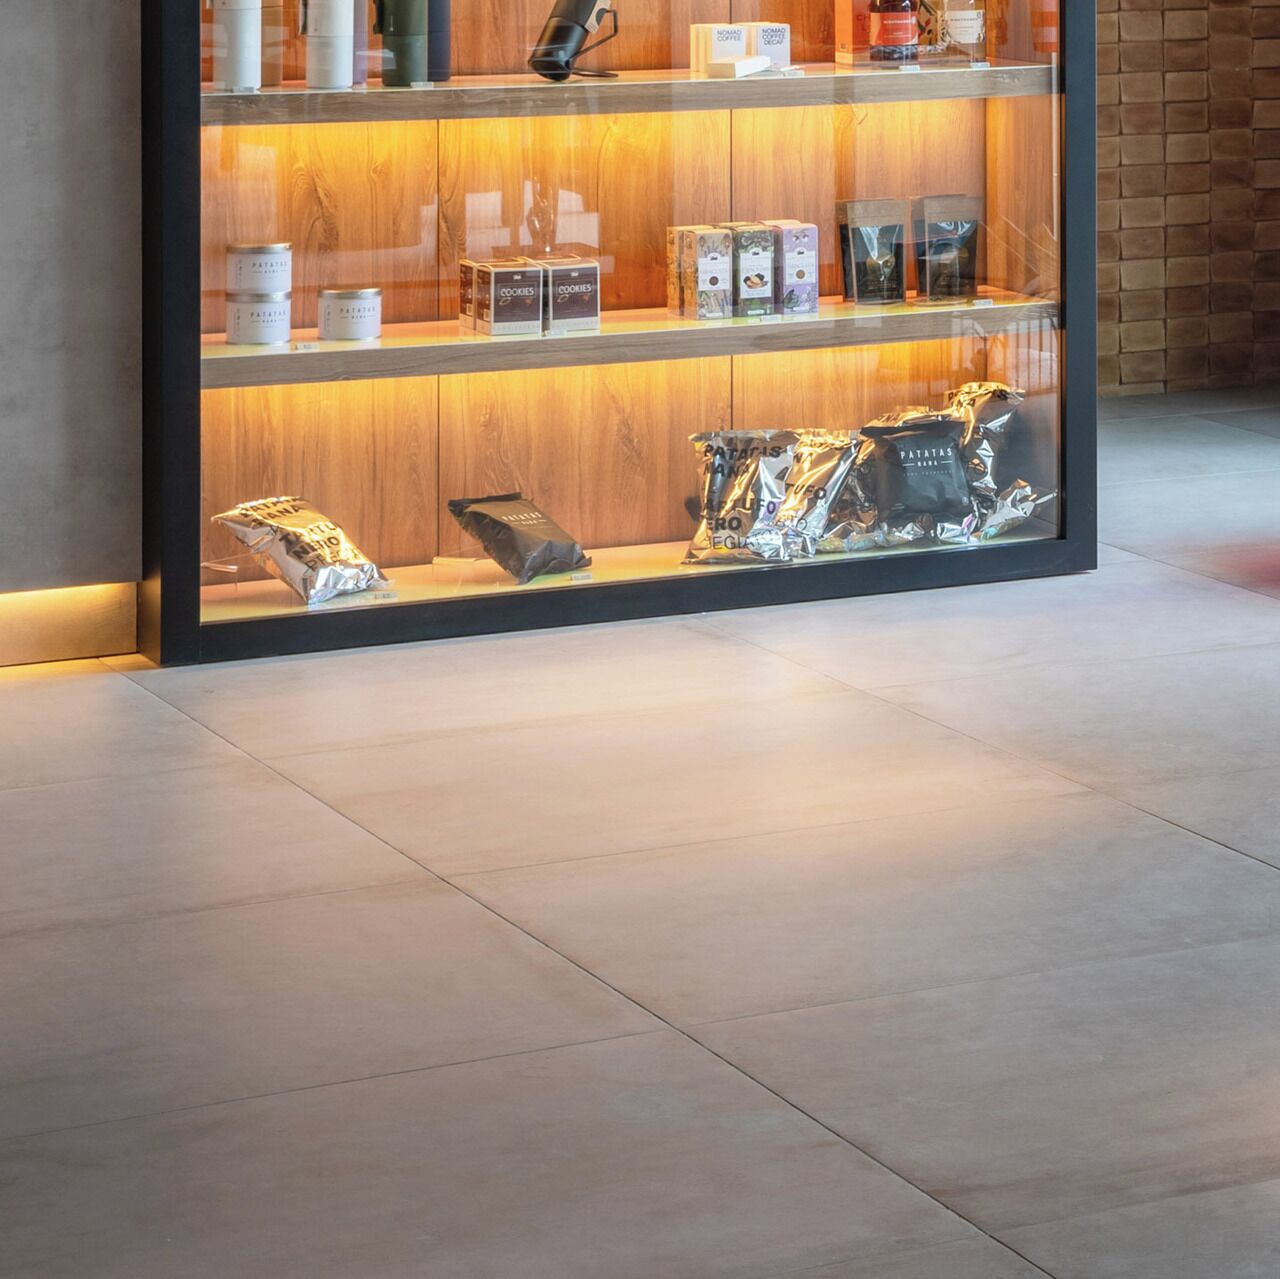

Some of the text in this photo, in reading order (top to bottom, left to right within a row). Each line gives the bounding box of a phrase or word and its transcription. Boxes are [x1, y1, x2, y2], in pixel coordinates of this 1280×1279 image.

[500, 287, 535, 297] COOKIES
[558, 283, 592, 294] COOKIES
[900, 447, 952, 460] PATATAS
